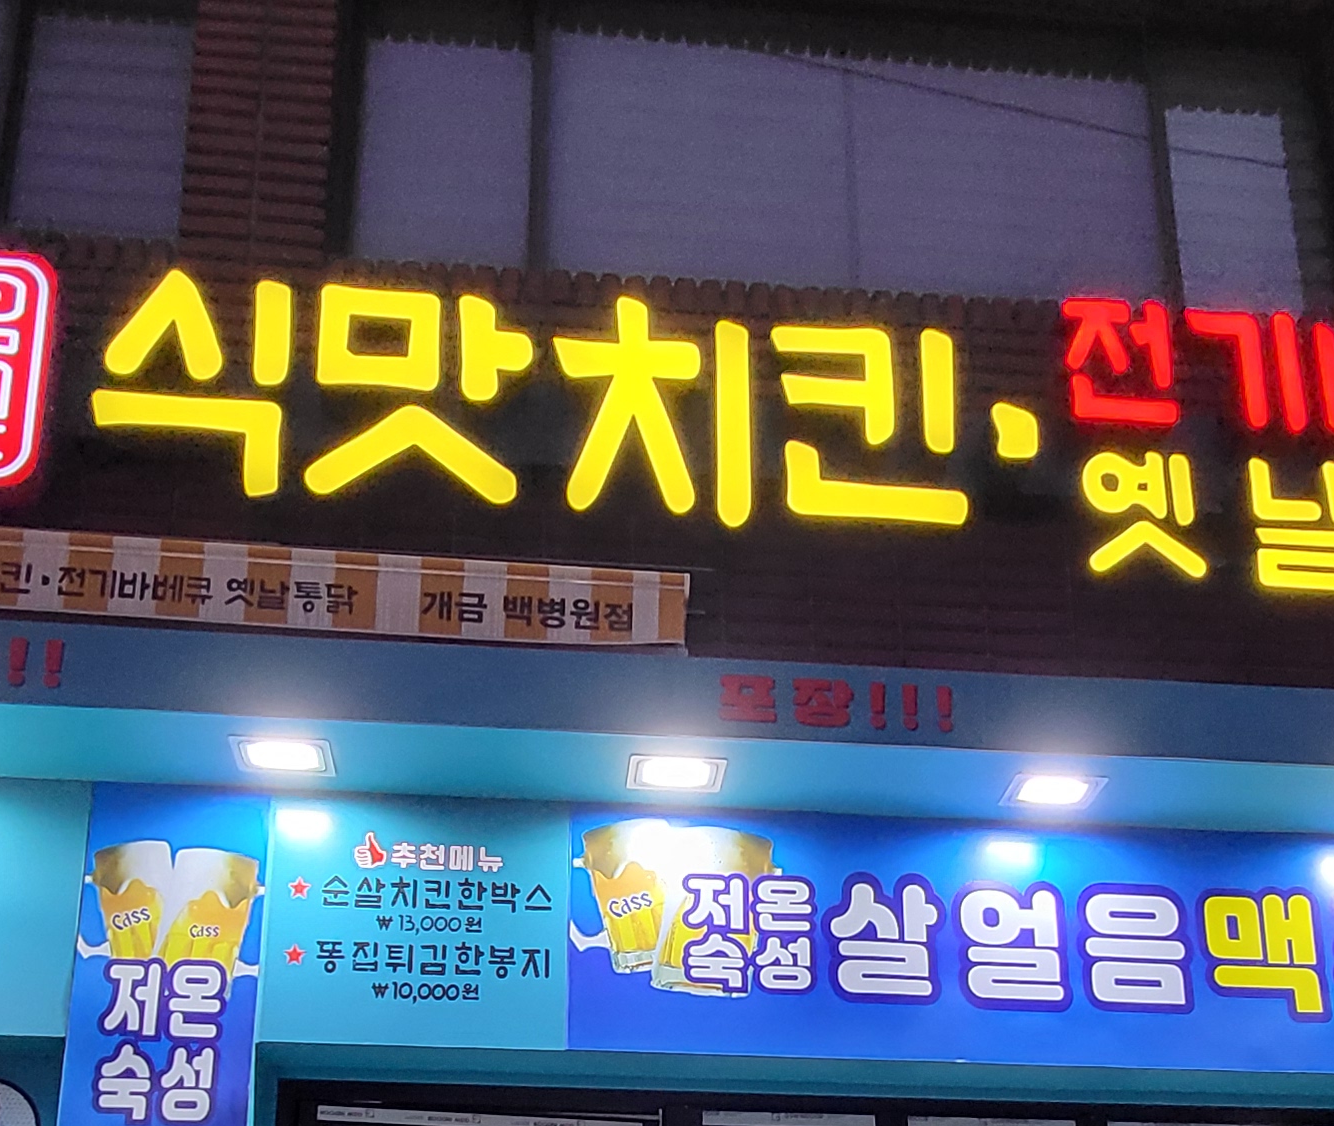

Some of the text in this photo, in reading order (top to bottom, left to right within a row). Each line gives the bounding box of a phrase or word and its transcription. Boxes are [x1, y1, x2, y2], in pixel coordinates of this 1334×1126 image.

[224, 578, 358, 615] 옛날통닭
[421, 591, 487, 624] 개금
[503, 595, 634, 633] 백병원점
[390, 842, 504, 872] 추천메뉴
[684, 875, 813, 933] 저온
[684, 932, 813, 993] 숙성
[103, 961, 224, 1038] 저온
[97, 1044, 215, 1121] 숙성
